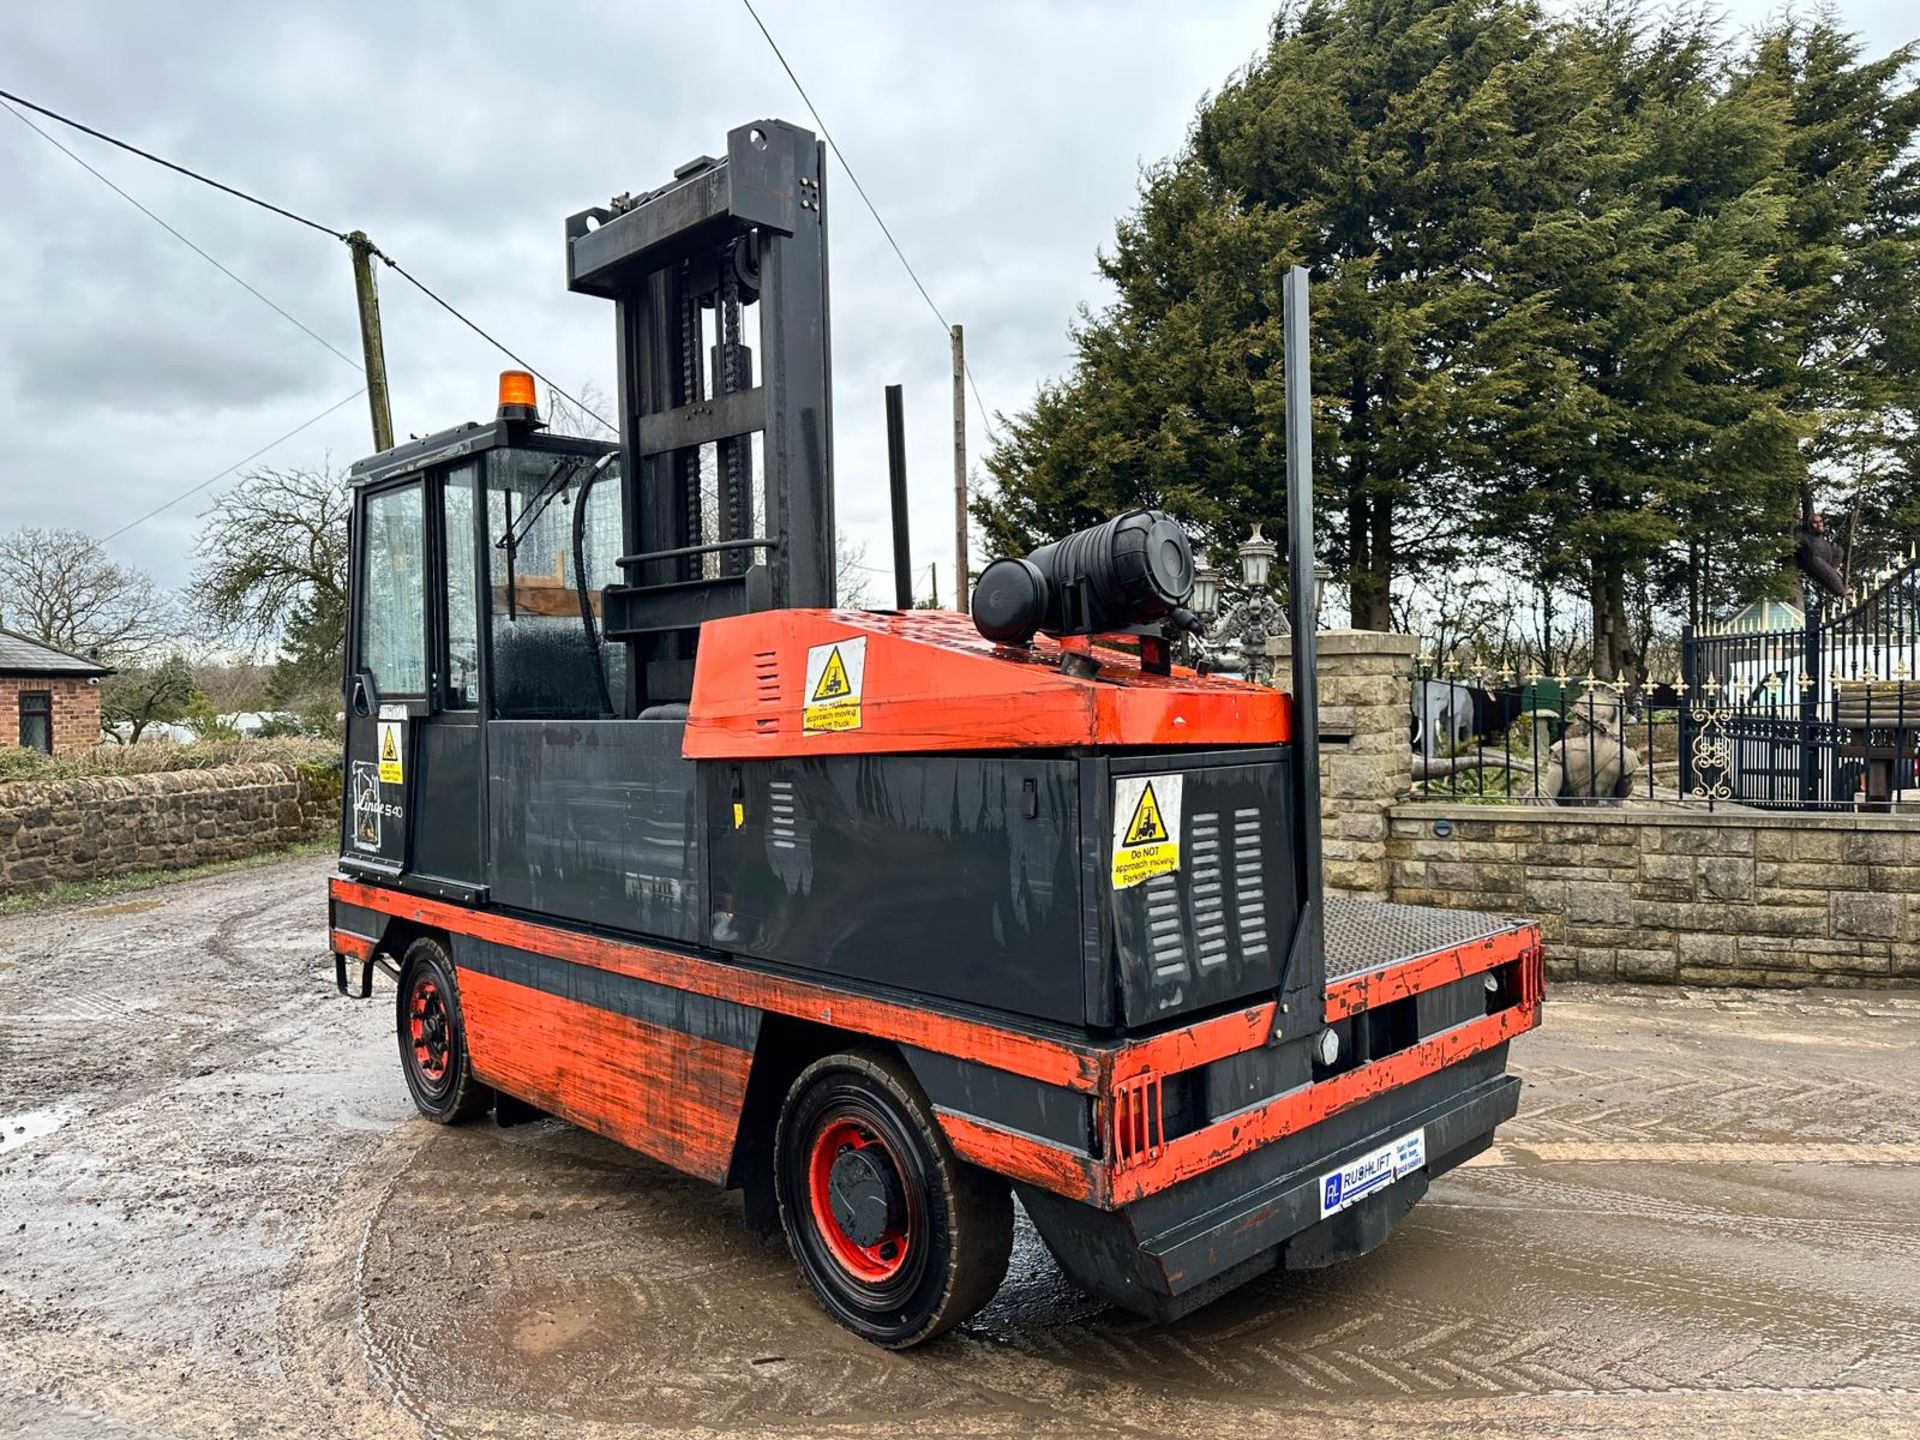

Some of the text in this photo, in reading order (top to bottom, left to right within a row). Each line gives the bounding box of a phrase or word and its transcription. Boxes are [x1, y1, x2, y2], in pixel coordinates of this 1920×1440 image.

[354, 796, 385, 815] Linde
[1131, 846, 1160, 860] Do NOT
[1149, 857, 1175, 867] moving
[1343, 1152, 1392, 1189] RUSHLIFT
